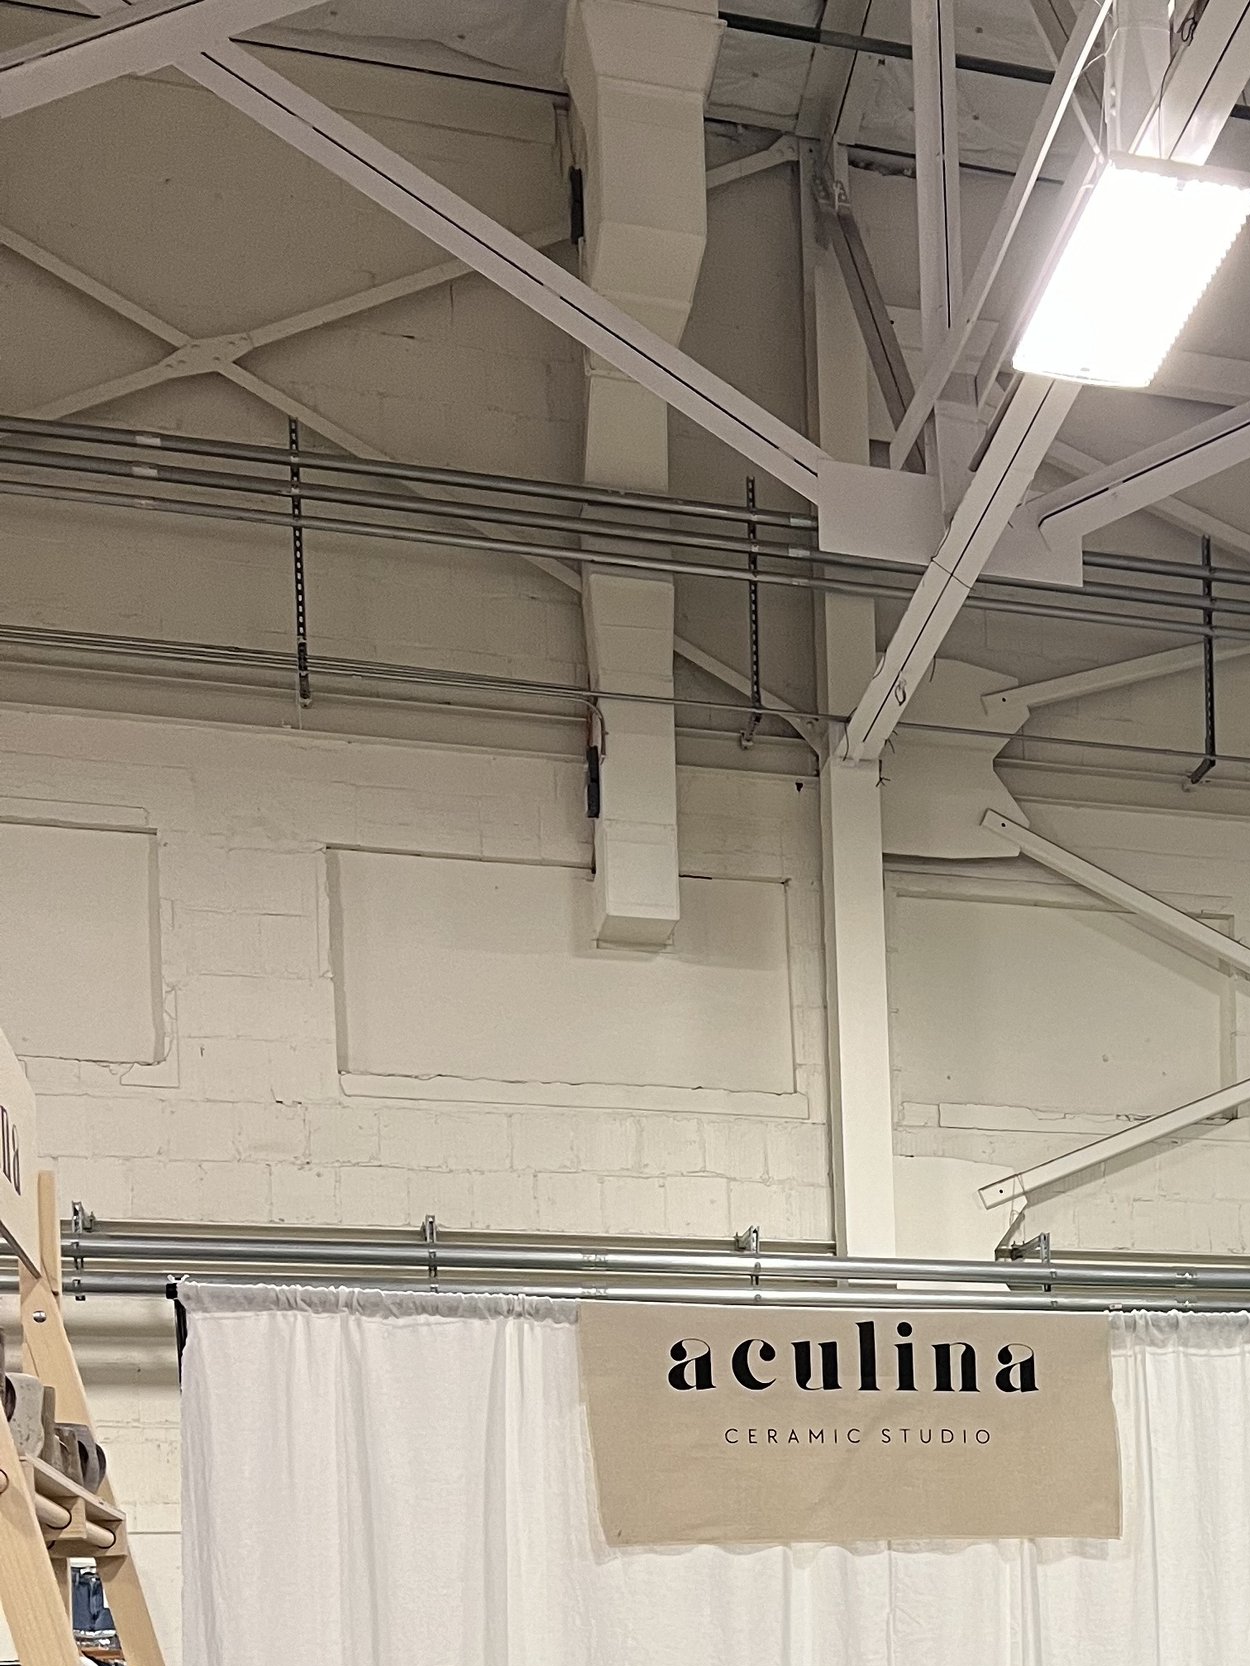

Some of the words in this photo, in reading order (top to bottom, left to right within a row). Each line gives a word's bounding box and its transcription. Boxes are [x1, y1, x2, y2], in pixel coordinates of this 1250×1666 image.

[667, 1320, 1040, 1393] aculina
[724, 1427, 861, 1445] CERAMIC
[881, 1428, 991, 1445] STUDIO
